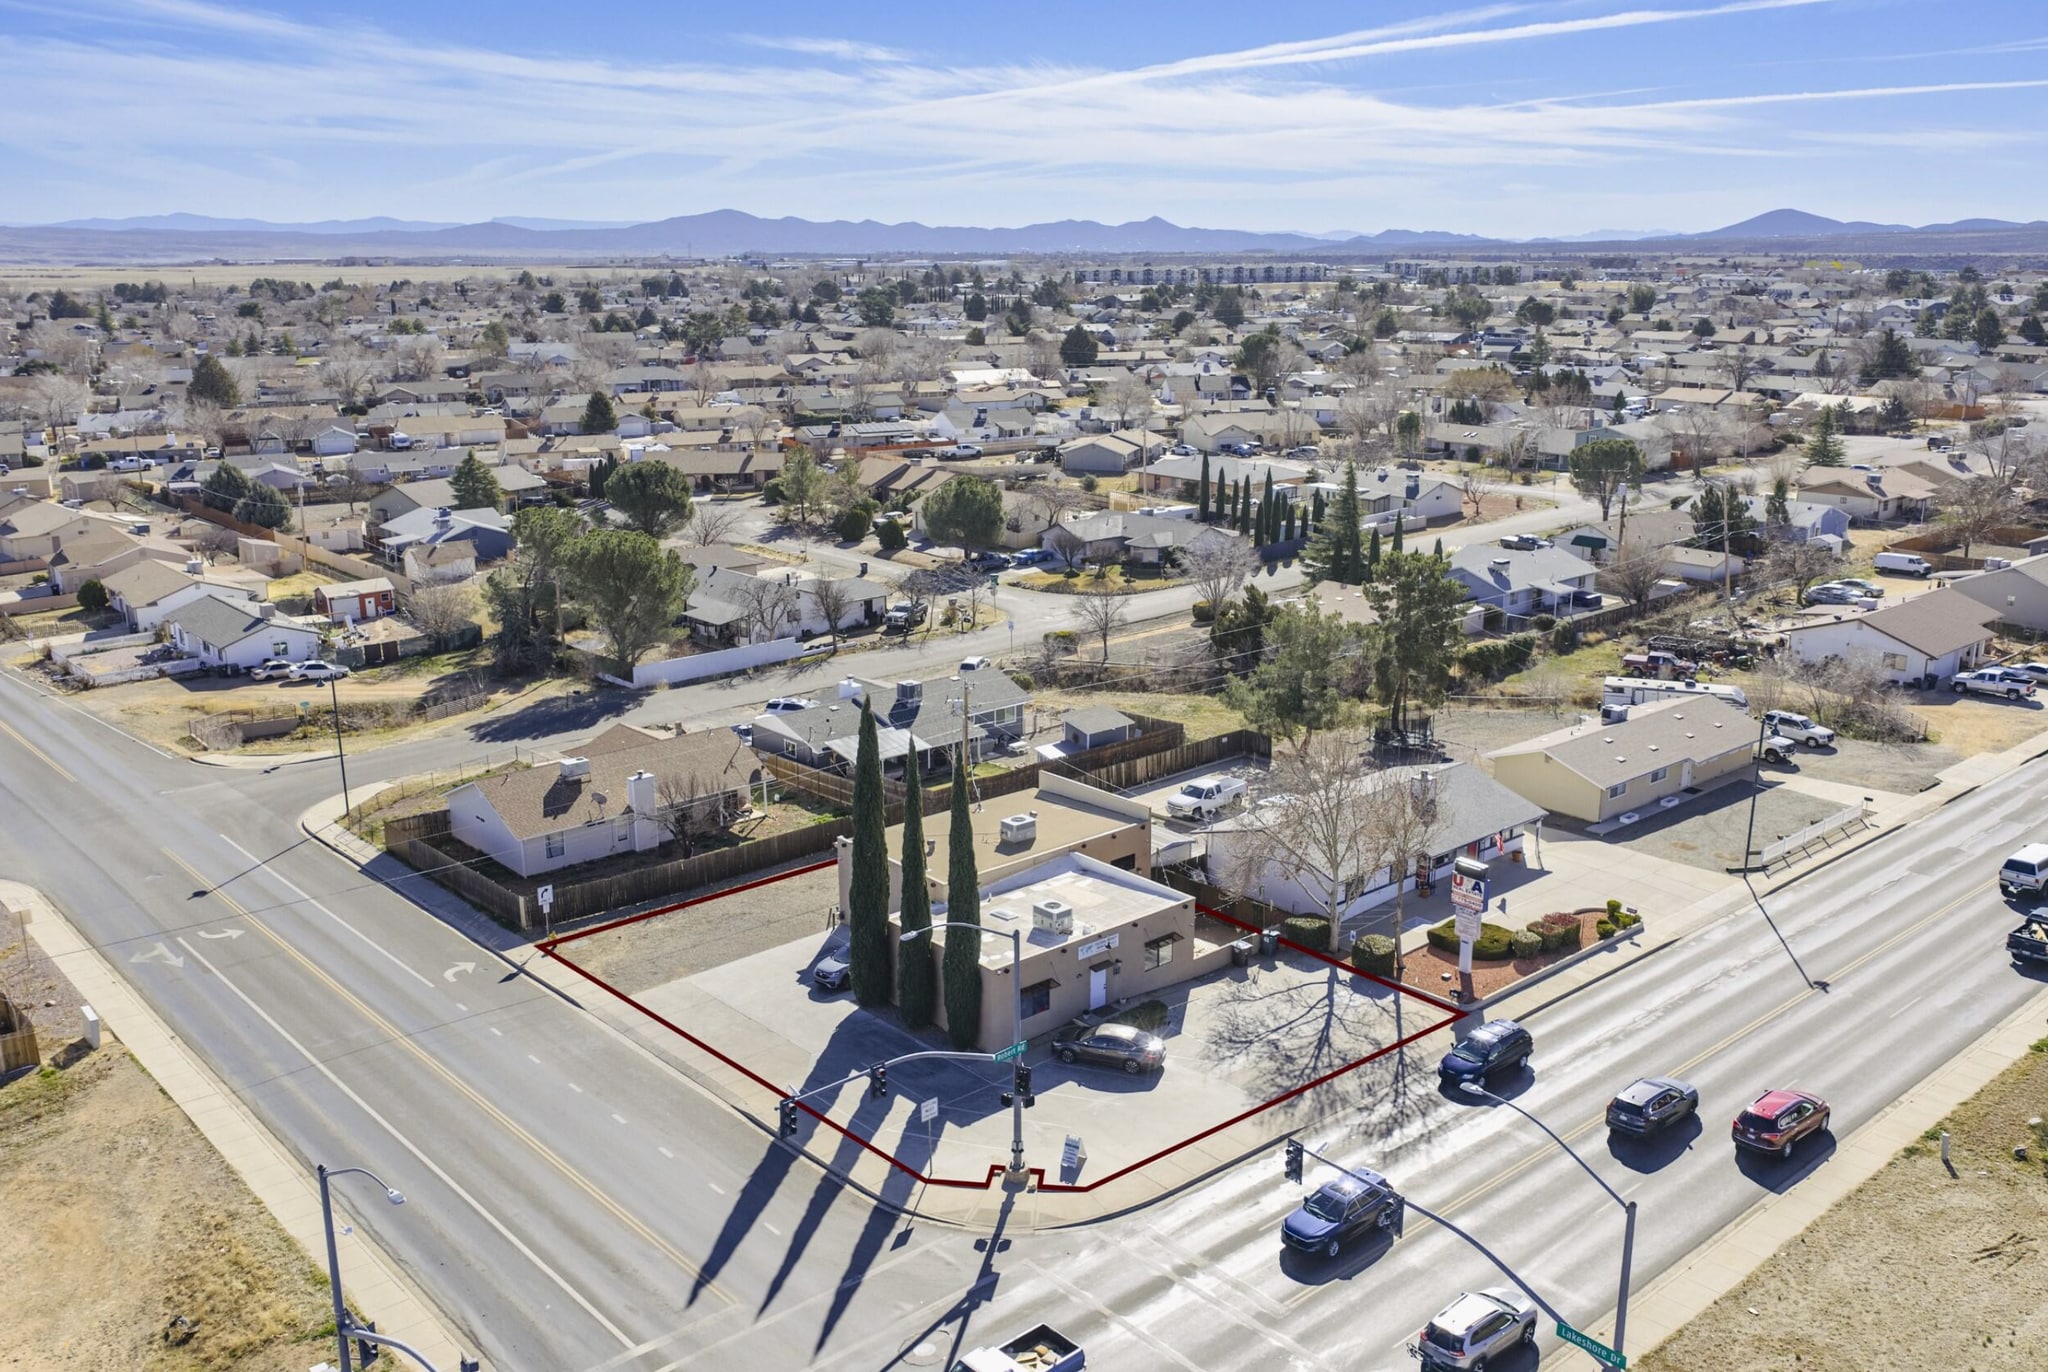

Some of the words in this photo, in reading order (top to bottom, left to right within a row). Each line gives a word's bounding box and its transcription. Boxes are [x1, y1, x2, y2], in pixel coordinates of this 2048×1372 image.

[1472, 881, 1482, 893] A
[997, 1047, 1016, 1061] Robert
[1562, 1327, 1607, 1358] Lakeshore
[1610, 1353, 1621, 1365] Dr
